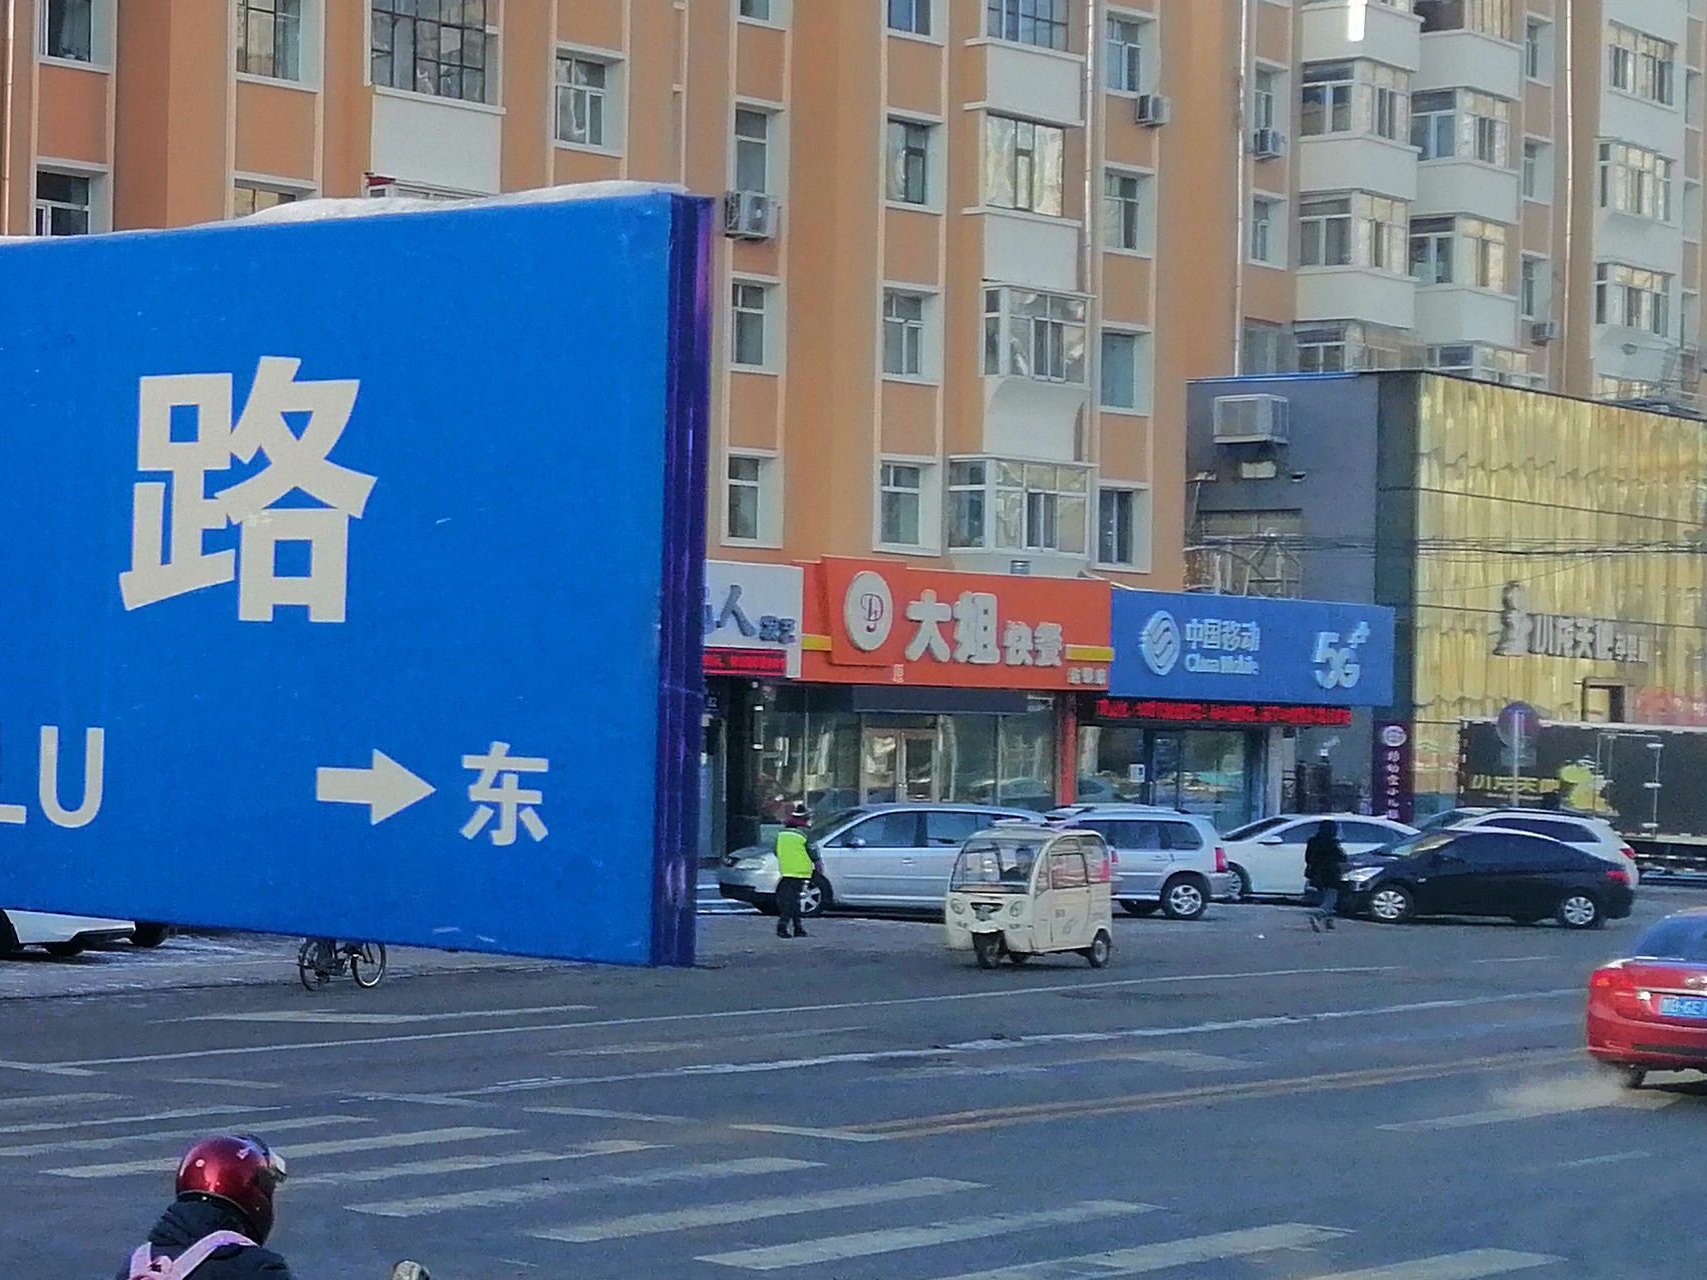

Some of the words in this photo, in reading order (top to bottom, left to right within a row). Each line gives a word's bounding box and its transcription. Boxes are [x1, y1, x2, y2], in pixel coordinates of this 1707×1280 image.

[1186, 618, 1260, 651] 中国移动
[459, 742, 549, 846] 东
